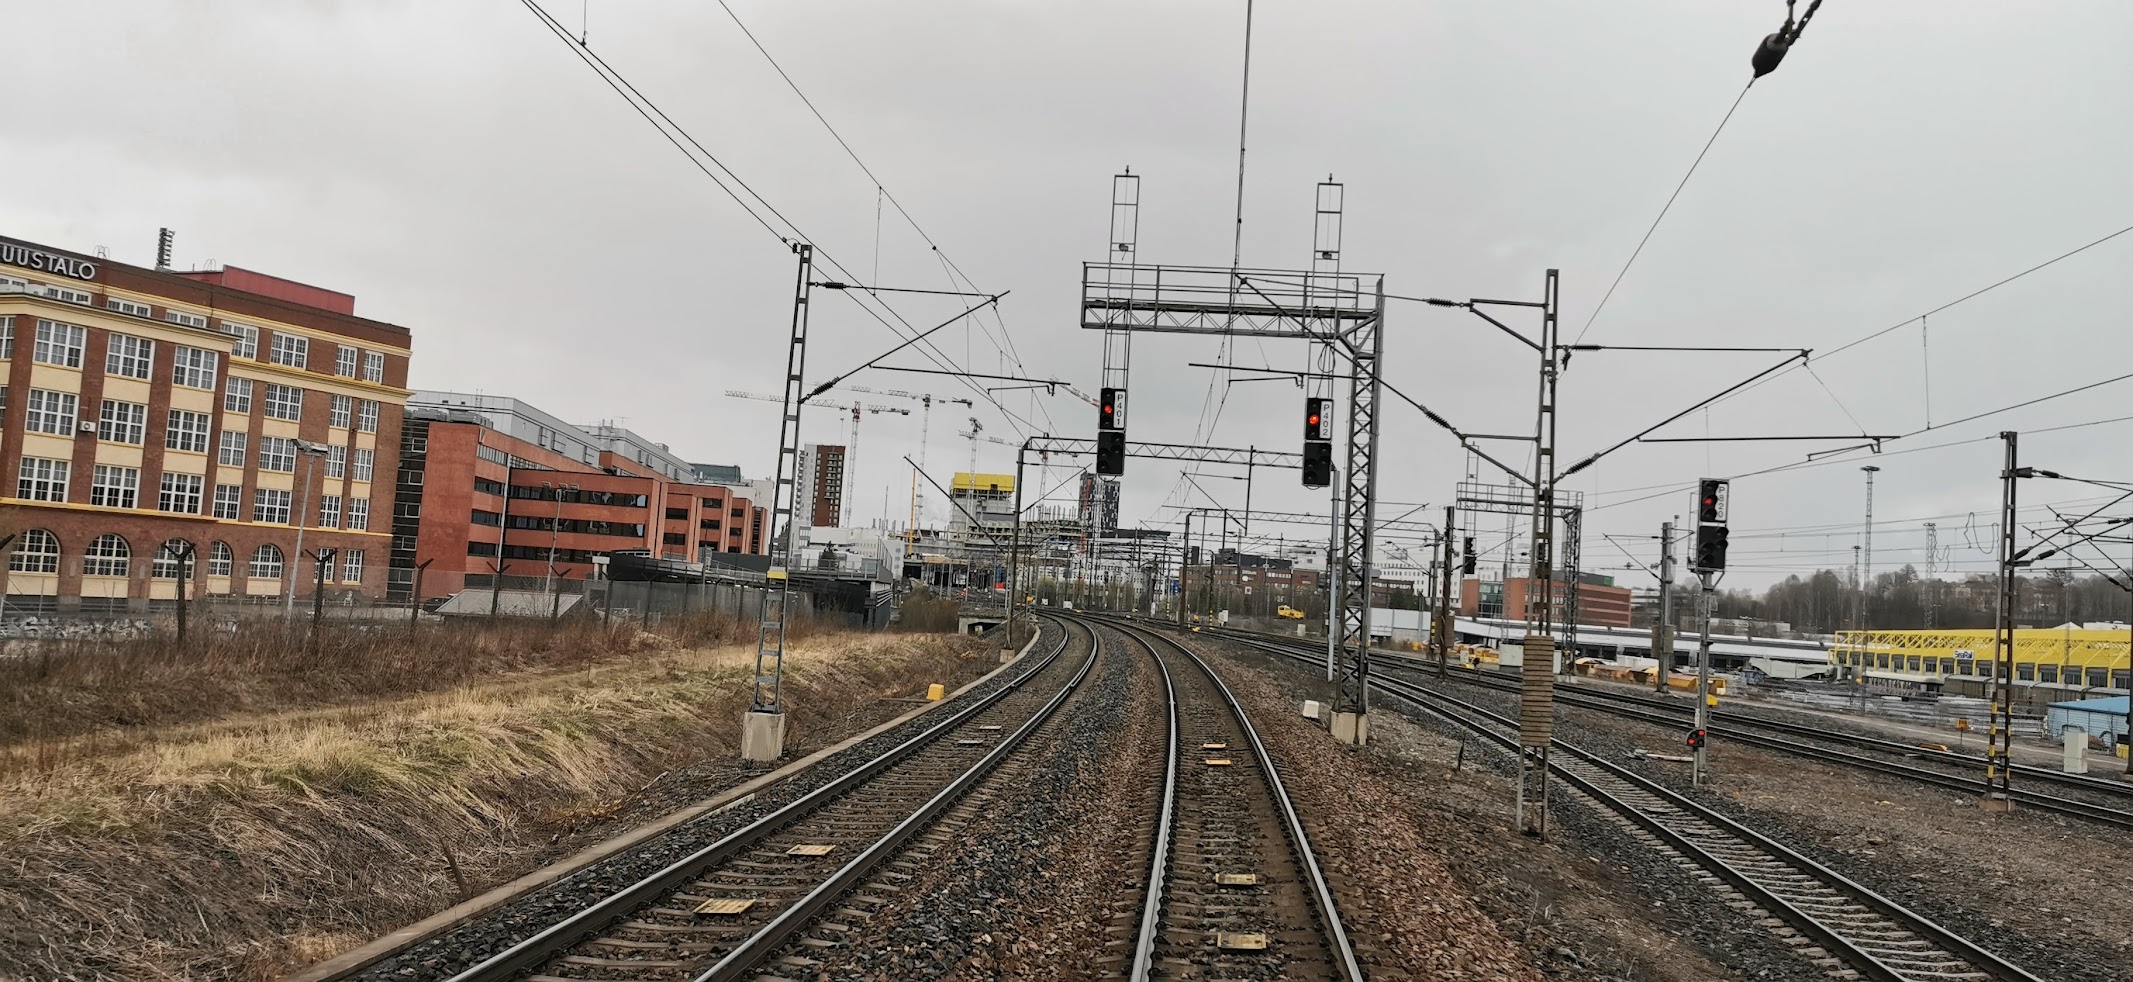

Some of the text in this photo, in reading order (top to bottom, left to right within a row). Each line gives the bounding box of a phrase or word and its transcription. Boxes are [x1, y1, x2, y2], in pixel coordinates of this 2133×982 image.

[2, 245, 96, 280] UUSTALO
[1116, 394, 1124, 425] P401
[1322, 404, 1330, 436] P402
